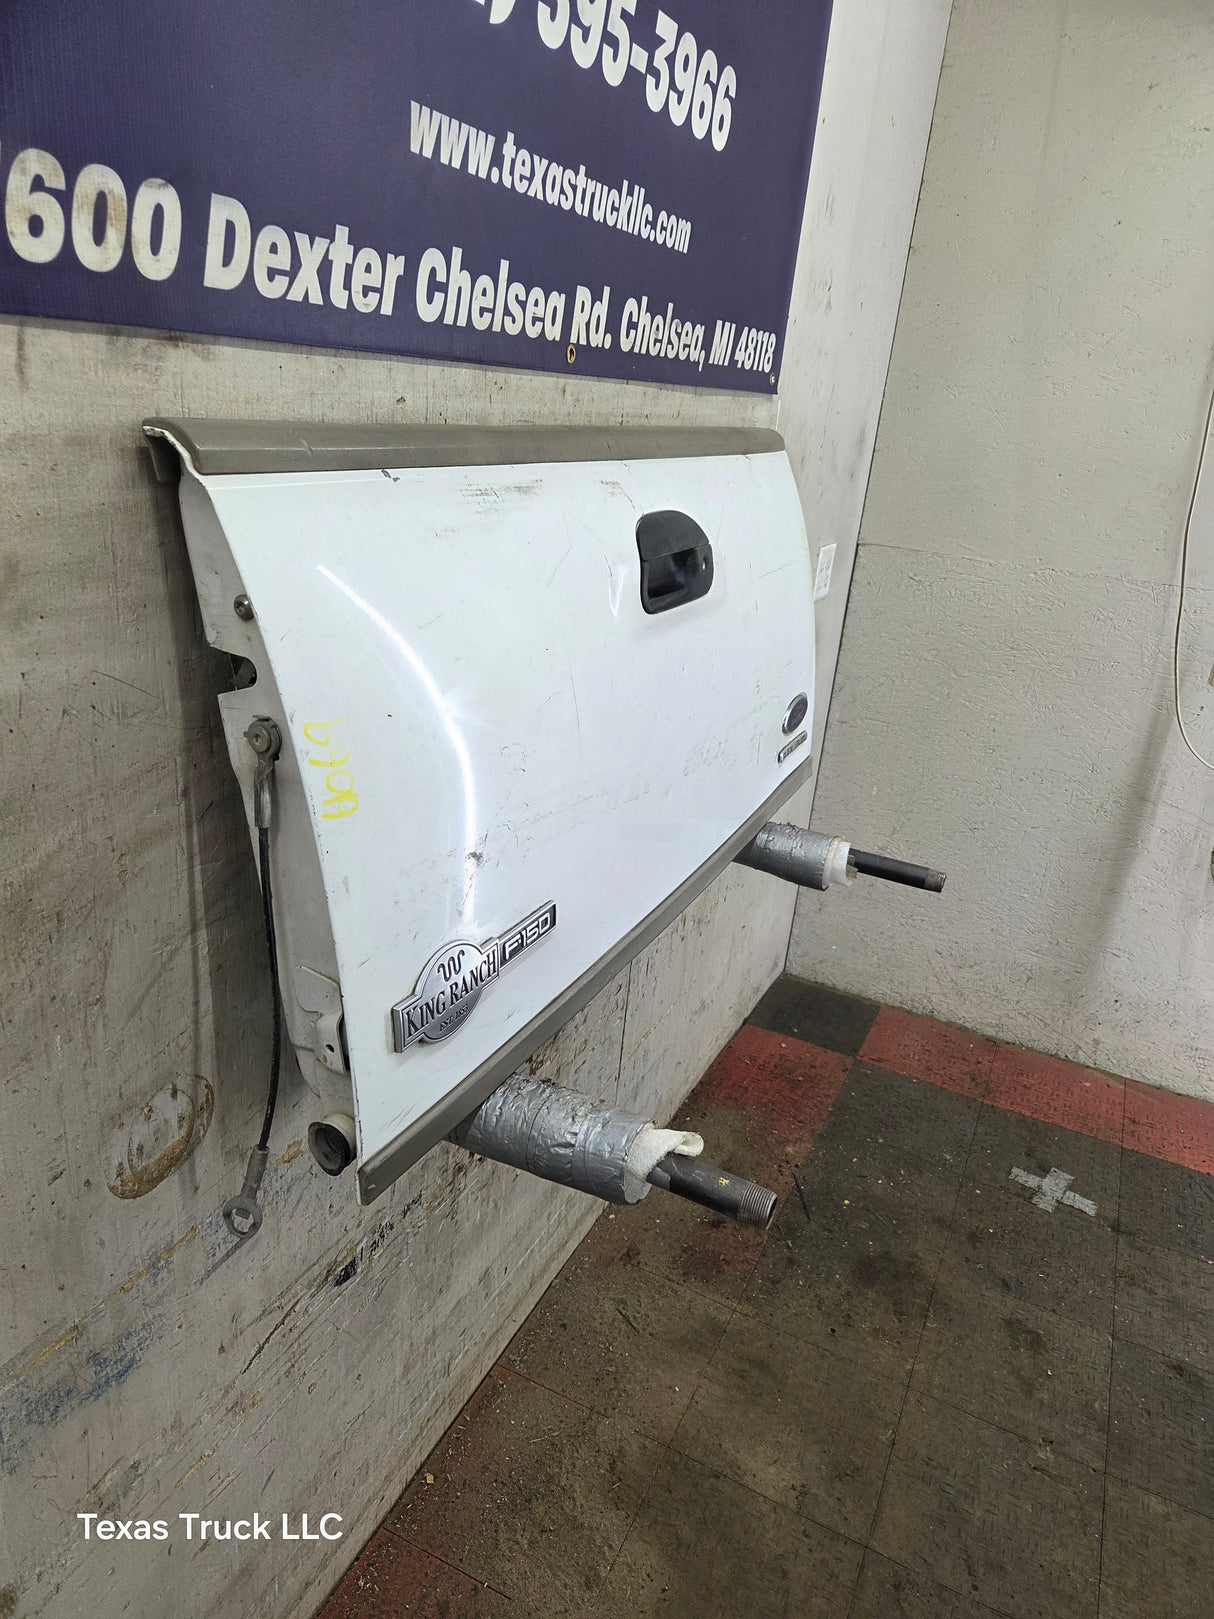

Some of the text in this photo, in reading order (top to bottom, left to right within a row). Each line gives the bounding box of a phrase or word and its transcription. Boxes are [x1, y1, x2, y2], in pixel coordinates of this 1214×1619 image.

[410, 99, 692, 254] www.texastruckllc.com
[0, 141, 777, 373] 600 Dexter Chelsea Rd. Chelsea, MI 48118
[405, 948, 497, 1038] KING RANCH
